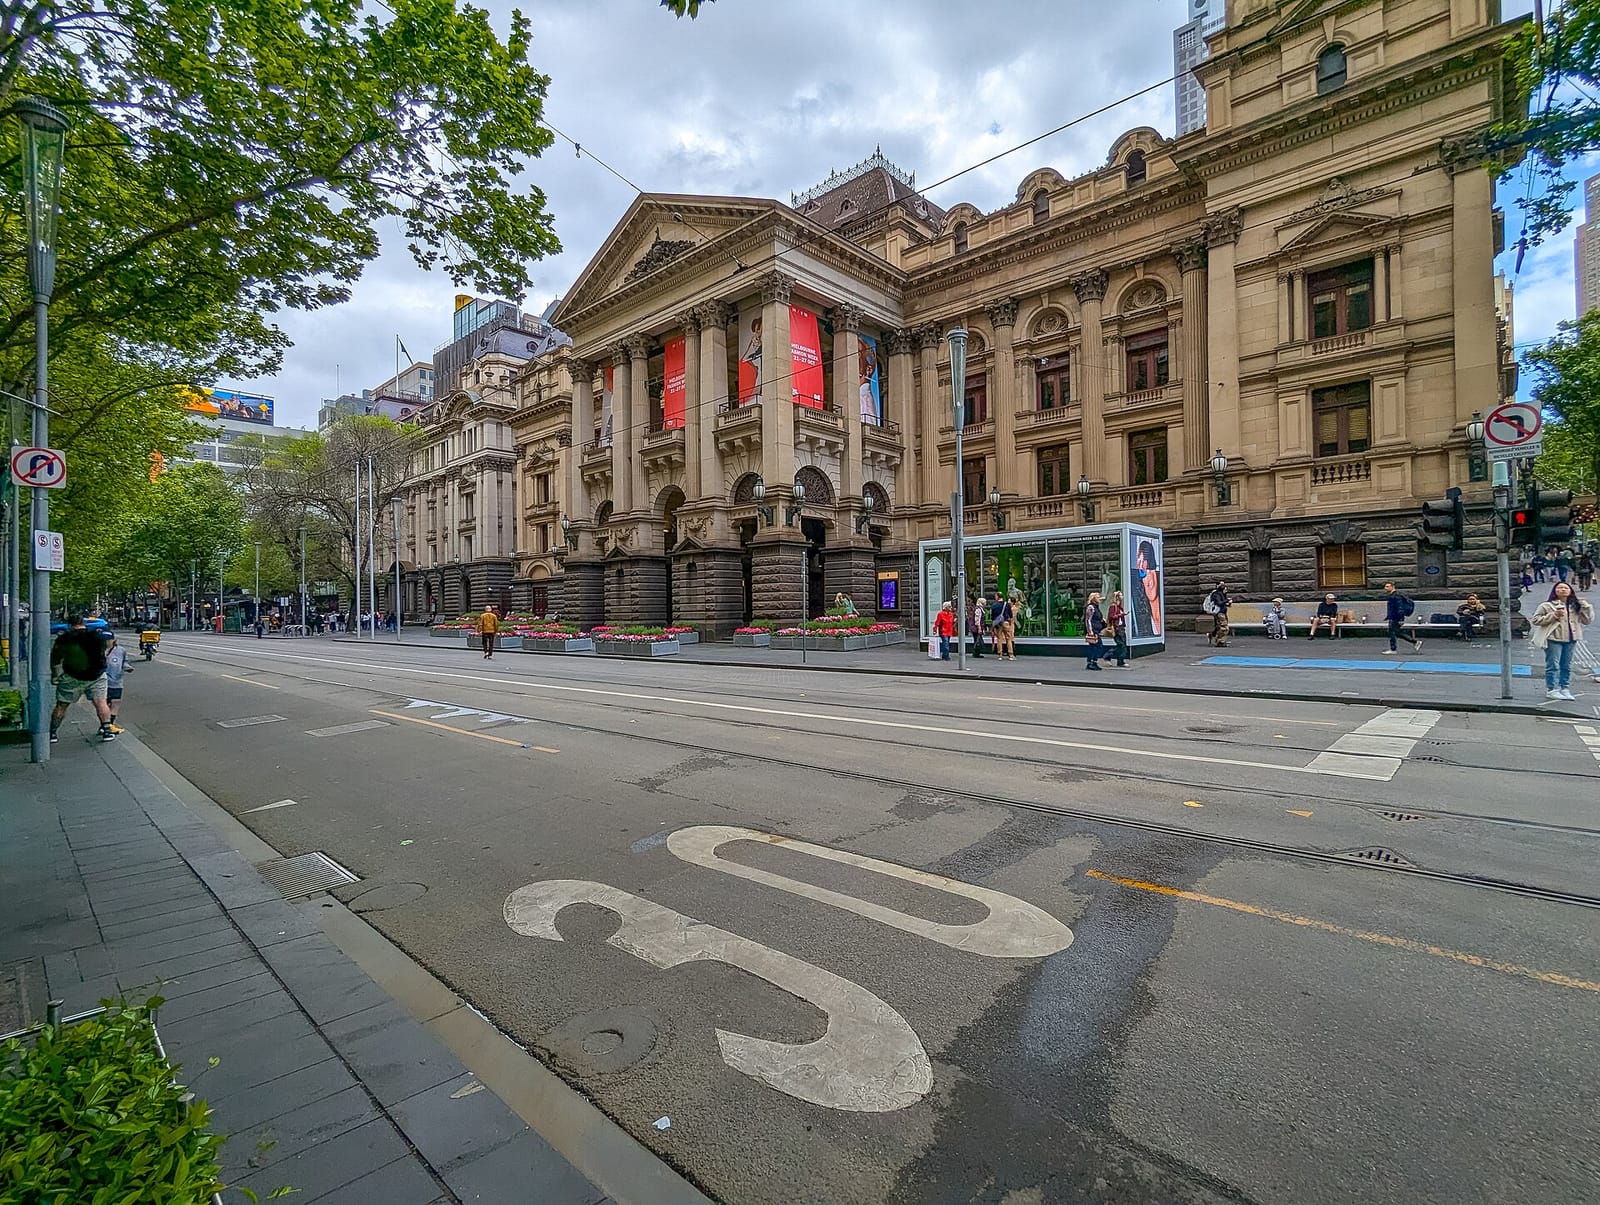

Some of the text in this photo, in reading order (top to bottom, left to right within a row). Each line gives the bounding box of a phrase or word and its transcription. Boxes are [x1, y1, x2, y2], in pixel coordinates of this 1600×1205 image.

[791, 343, 816, 355] MELBOURNE
[791, 349, 818, 362] ASHION WEEK
[792, 355, 806, 363] 21-27
[503, 825, 1074, 1113] 30
